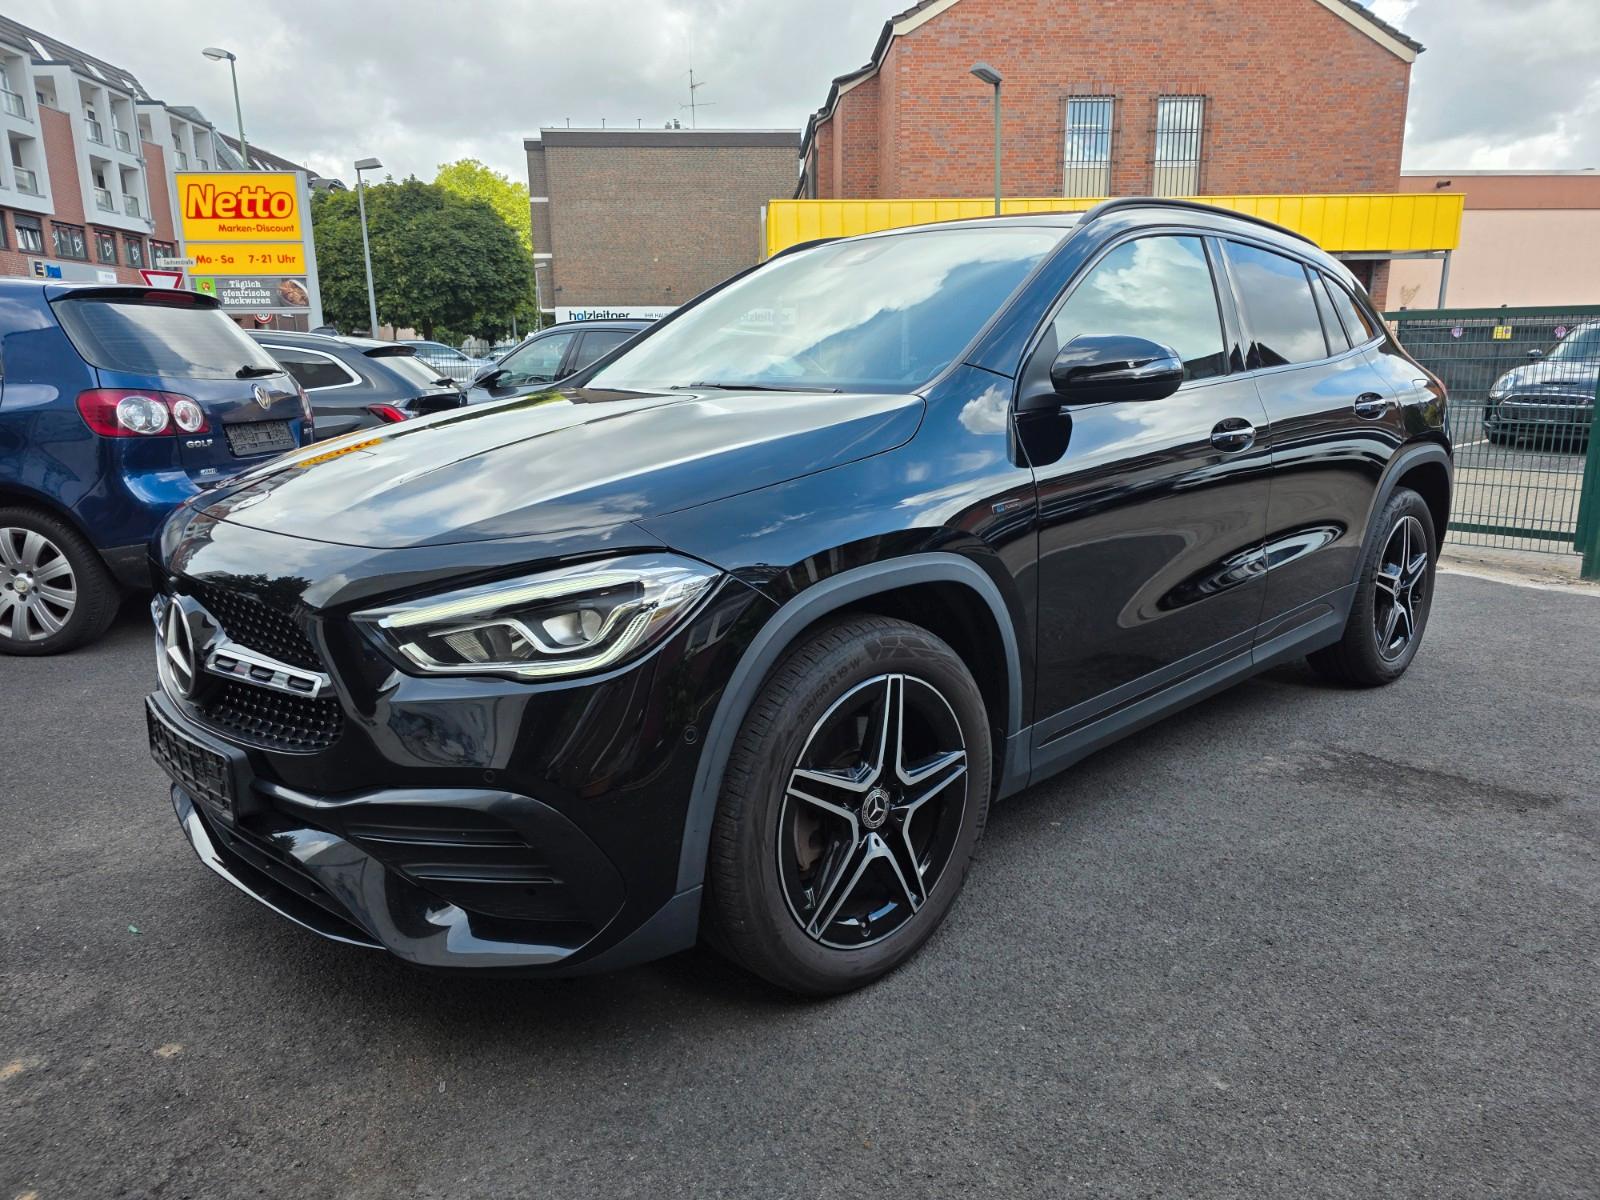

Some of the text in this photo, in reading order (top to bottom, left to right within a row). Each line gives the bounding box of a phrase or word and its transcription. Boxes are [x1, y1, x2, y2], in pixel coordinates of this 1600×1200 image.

[186, 183, 294, 219] Netto
[218, 224, 295, 233] Marken-Discount
[196, 255, 212, 264] Mo
[220, 255, 235, 264] Sa
[277, 255, 296, 264] Uhr
[229, 280, 262, 289] Täglich
[222, 289, 271, 298] ofenfrische
[224, 297, 272, 305] Backwaren
[568, 310, 630, 320] holzleitner
[186, 439, 213, 449] GOLF
